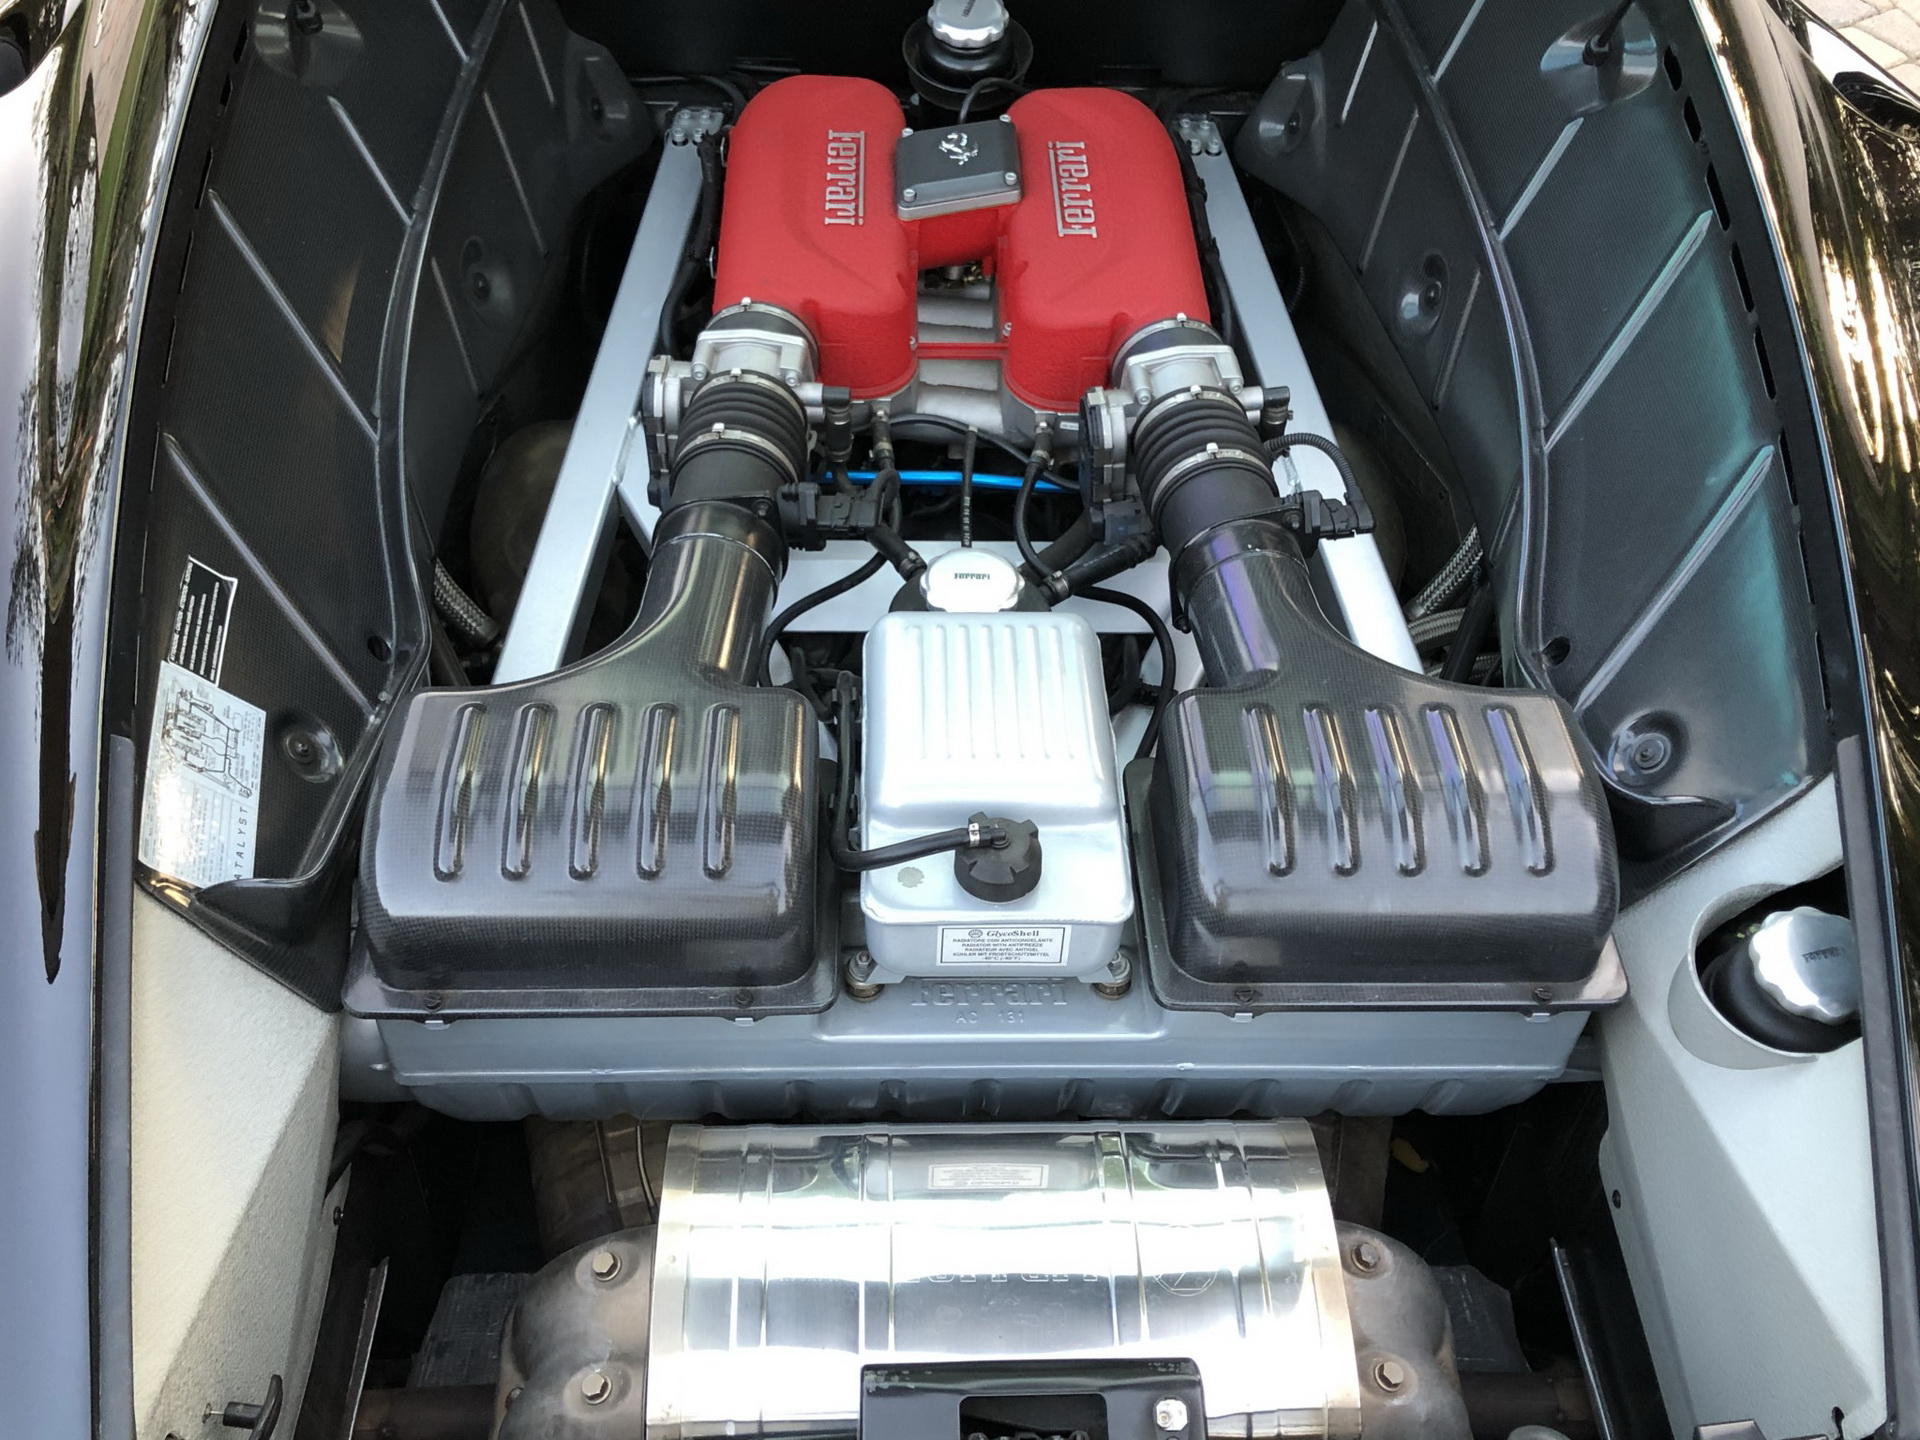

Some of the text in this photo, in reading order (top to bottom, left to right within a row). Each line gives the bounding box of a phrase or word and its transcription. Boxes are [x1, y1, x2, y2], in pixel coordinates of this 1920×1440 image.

[824, 129, 865, 226] Ferrari
[1048, 141, 1098, 238] Ferrari
[233, 806, 249, 880] ATALYST
[911, 978, 1069, 1006] Ferrari
